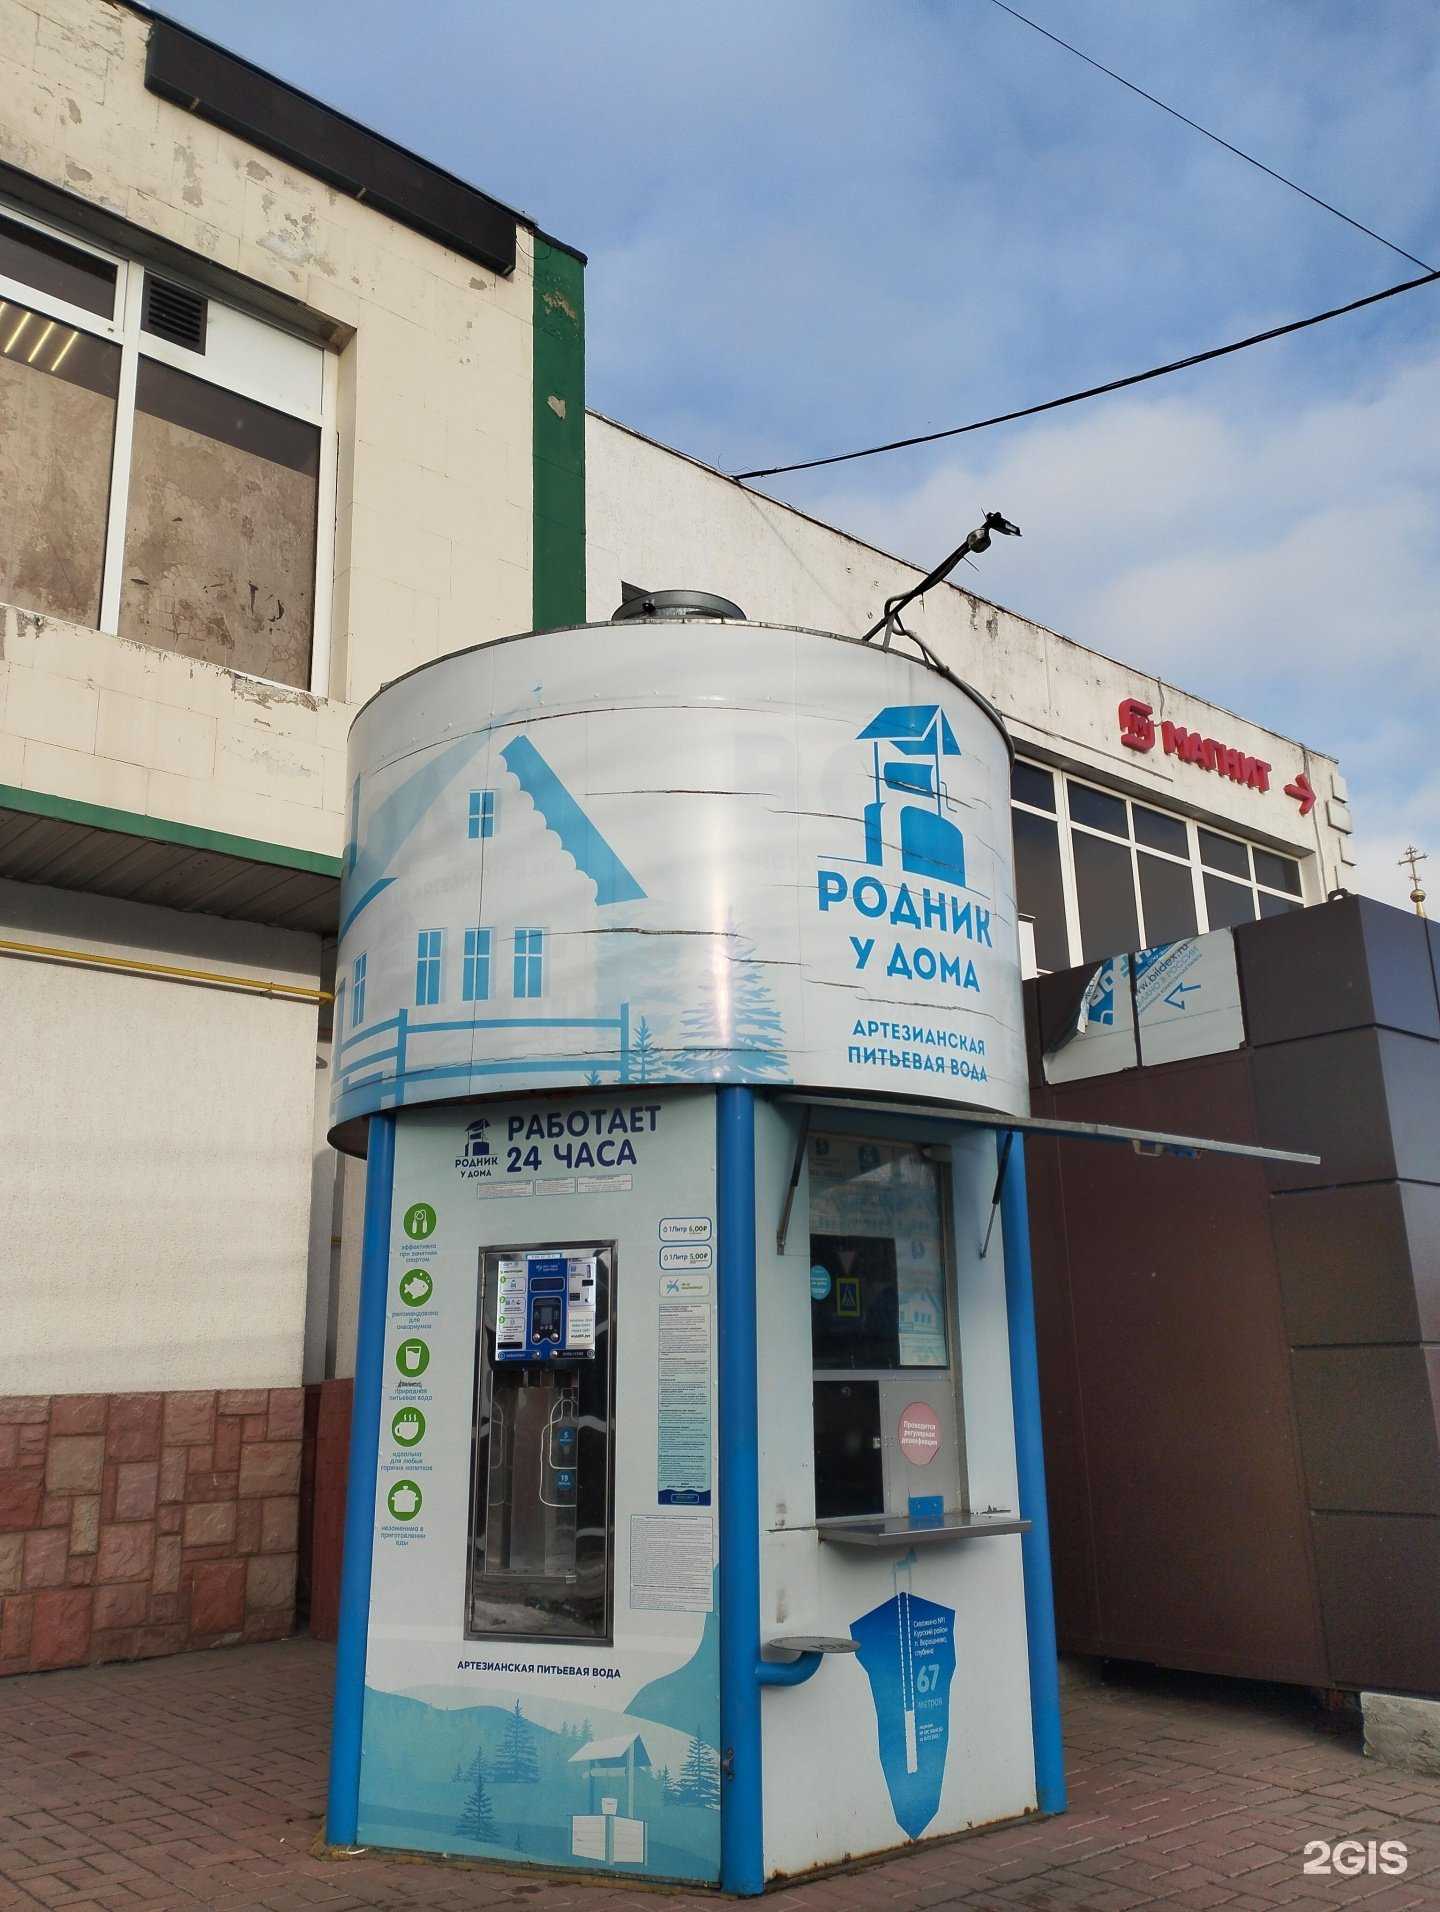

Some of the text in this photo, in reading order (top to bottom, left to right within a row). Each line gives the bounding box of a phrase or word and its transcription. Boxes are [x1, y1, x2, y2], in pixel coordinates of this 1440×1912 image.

[1161, 720, 1272, 794] МАГНИТ
[817, 870, 992, 948] РОДНИК
[849, 936, 980, 992] У ДОМА
[852, 1019, 985, 1055] АРТЕЗИАНСКАЯ
[848, 1047, 988, 1082] ПИТЬЕВАЯ ВОДА
[508, 1105, 661, 1141] РАБОТАЕТ
[455, 1156, 499, 1168] РОДНИК
[460, 1169, 492, 1178] У ДОМА
[506, 1139, 637, 1173] 24 ЧАСА
[457, 1660, 621, 1680] АРТЕЗИАНСКАЯ ПИТЬЕВАЯ ВОДА
[917, 1664, 940, 1693] 67
